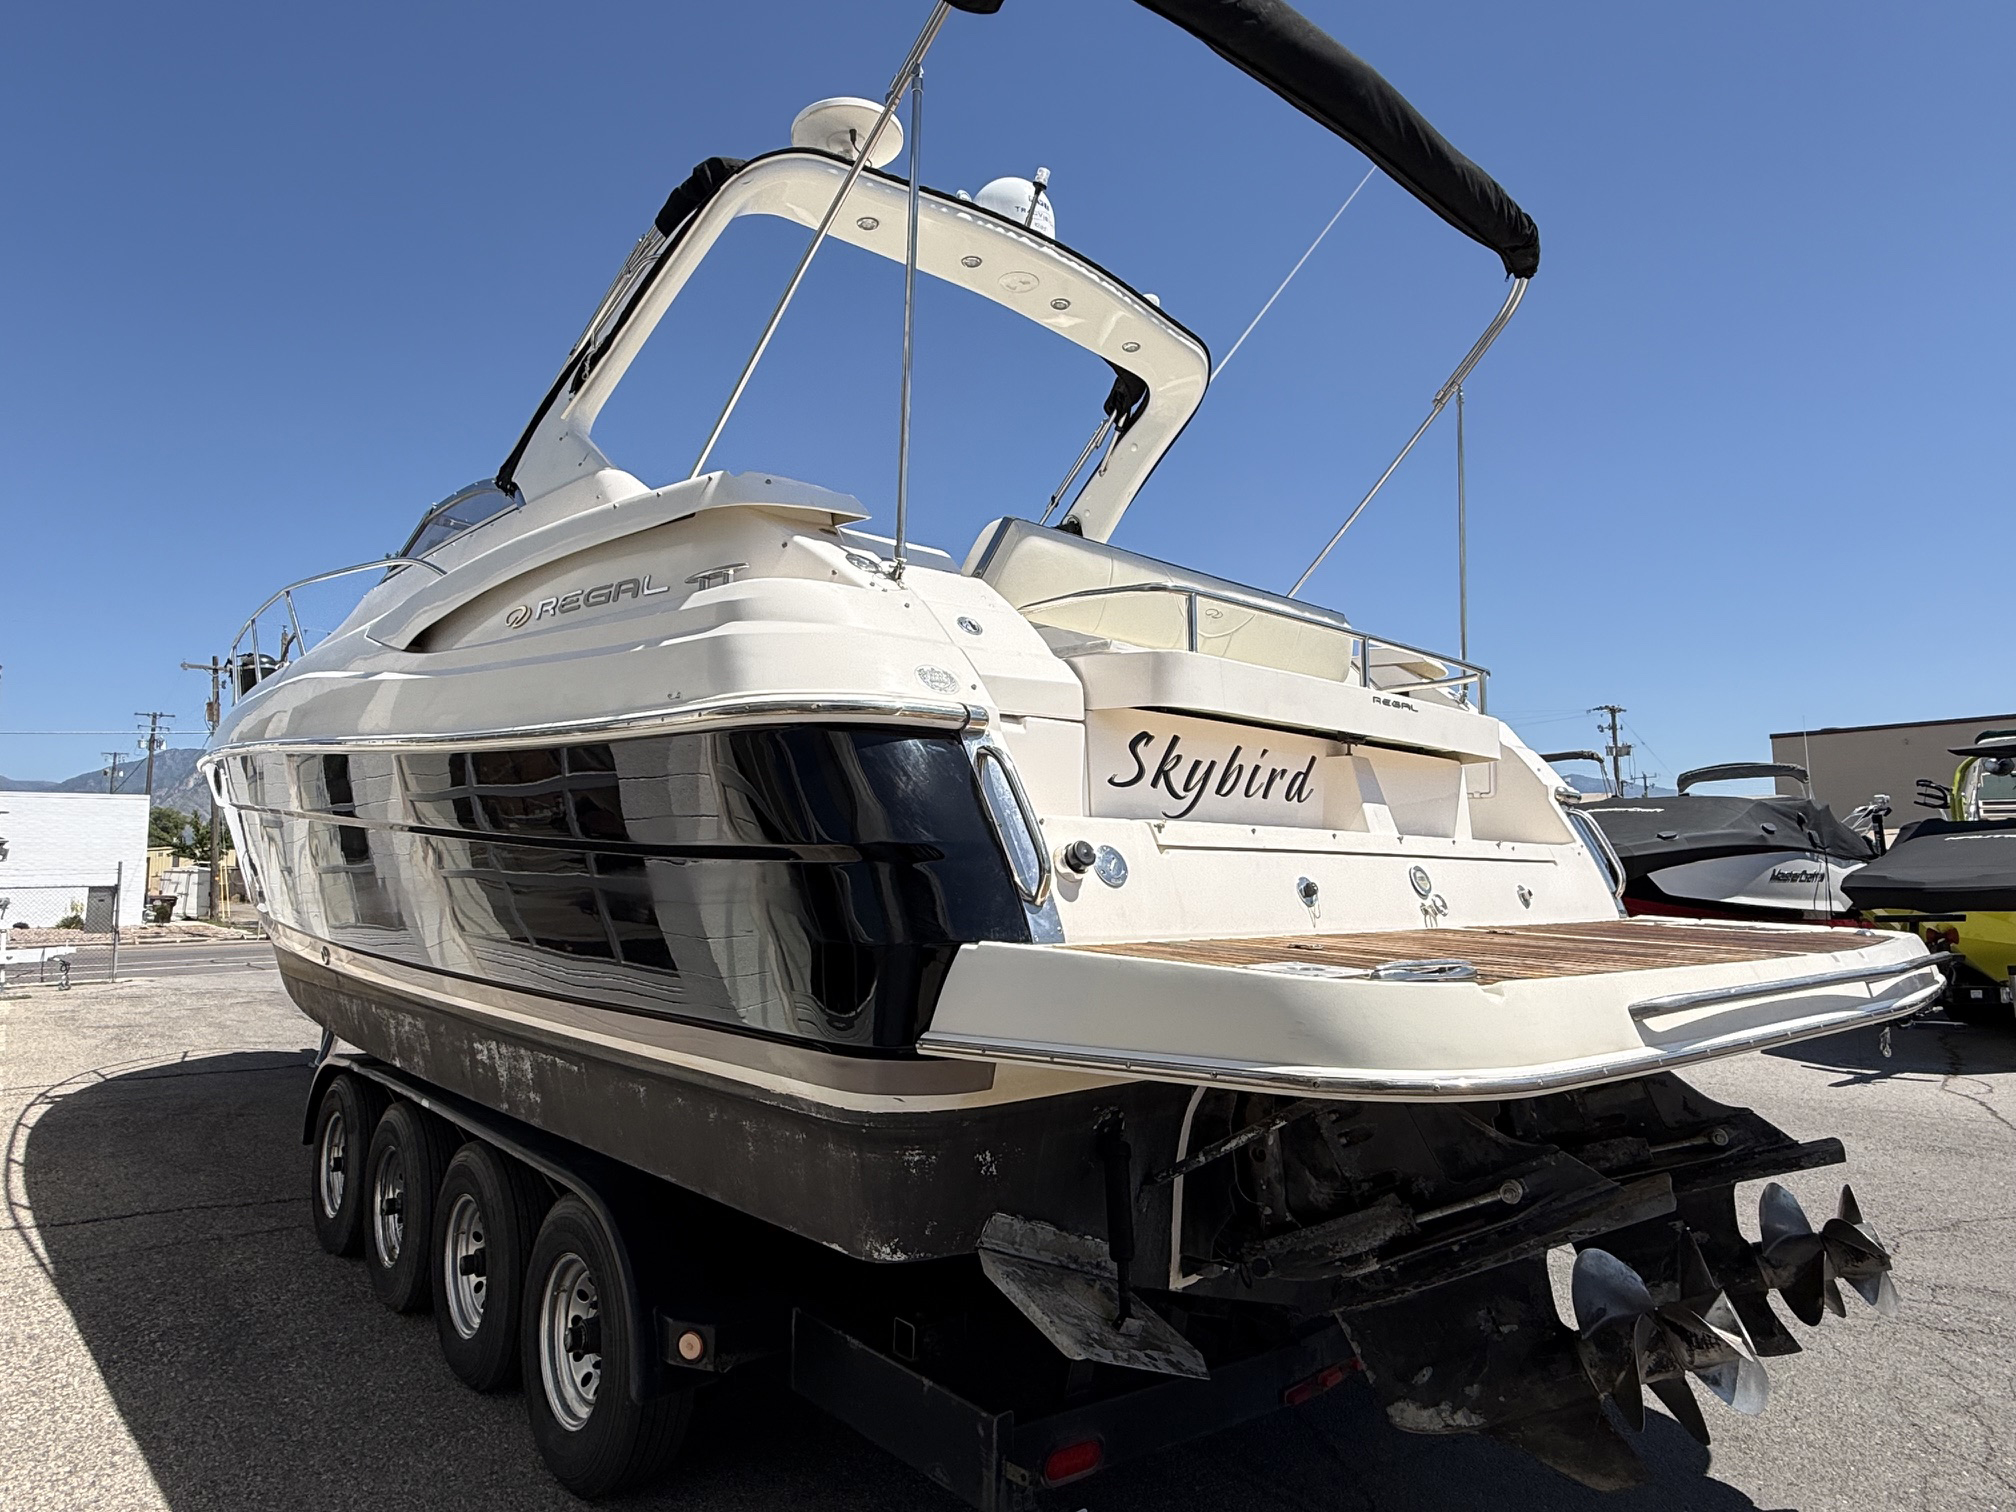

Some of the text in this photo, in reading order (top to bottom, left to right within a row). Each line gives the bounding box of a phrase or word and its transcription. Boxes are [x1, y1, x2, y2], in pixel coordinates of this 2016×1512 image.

[535, 574, 669, 620] REGAL
[1372, 696, 1419, 713] REGAL
[1107, 730, 1318, 819] Skybird
